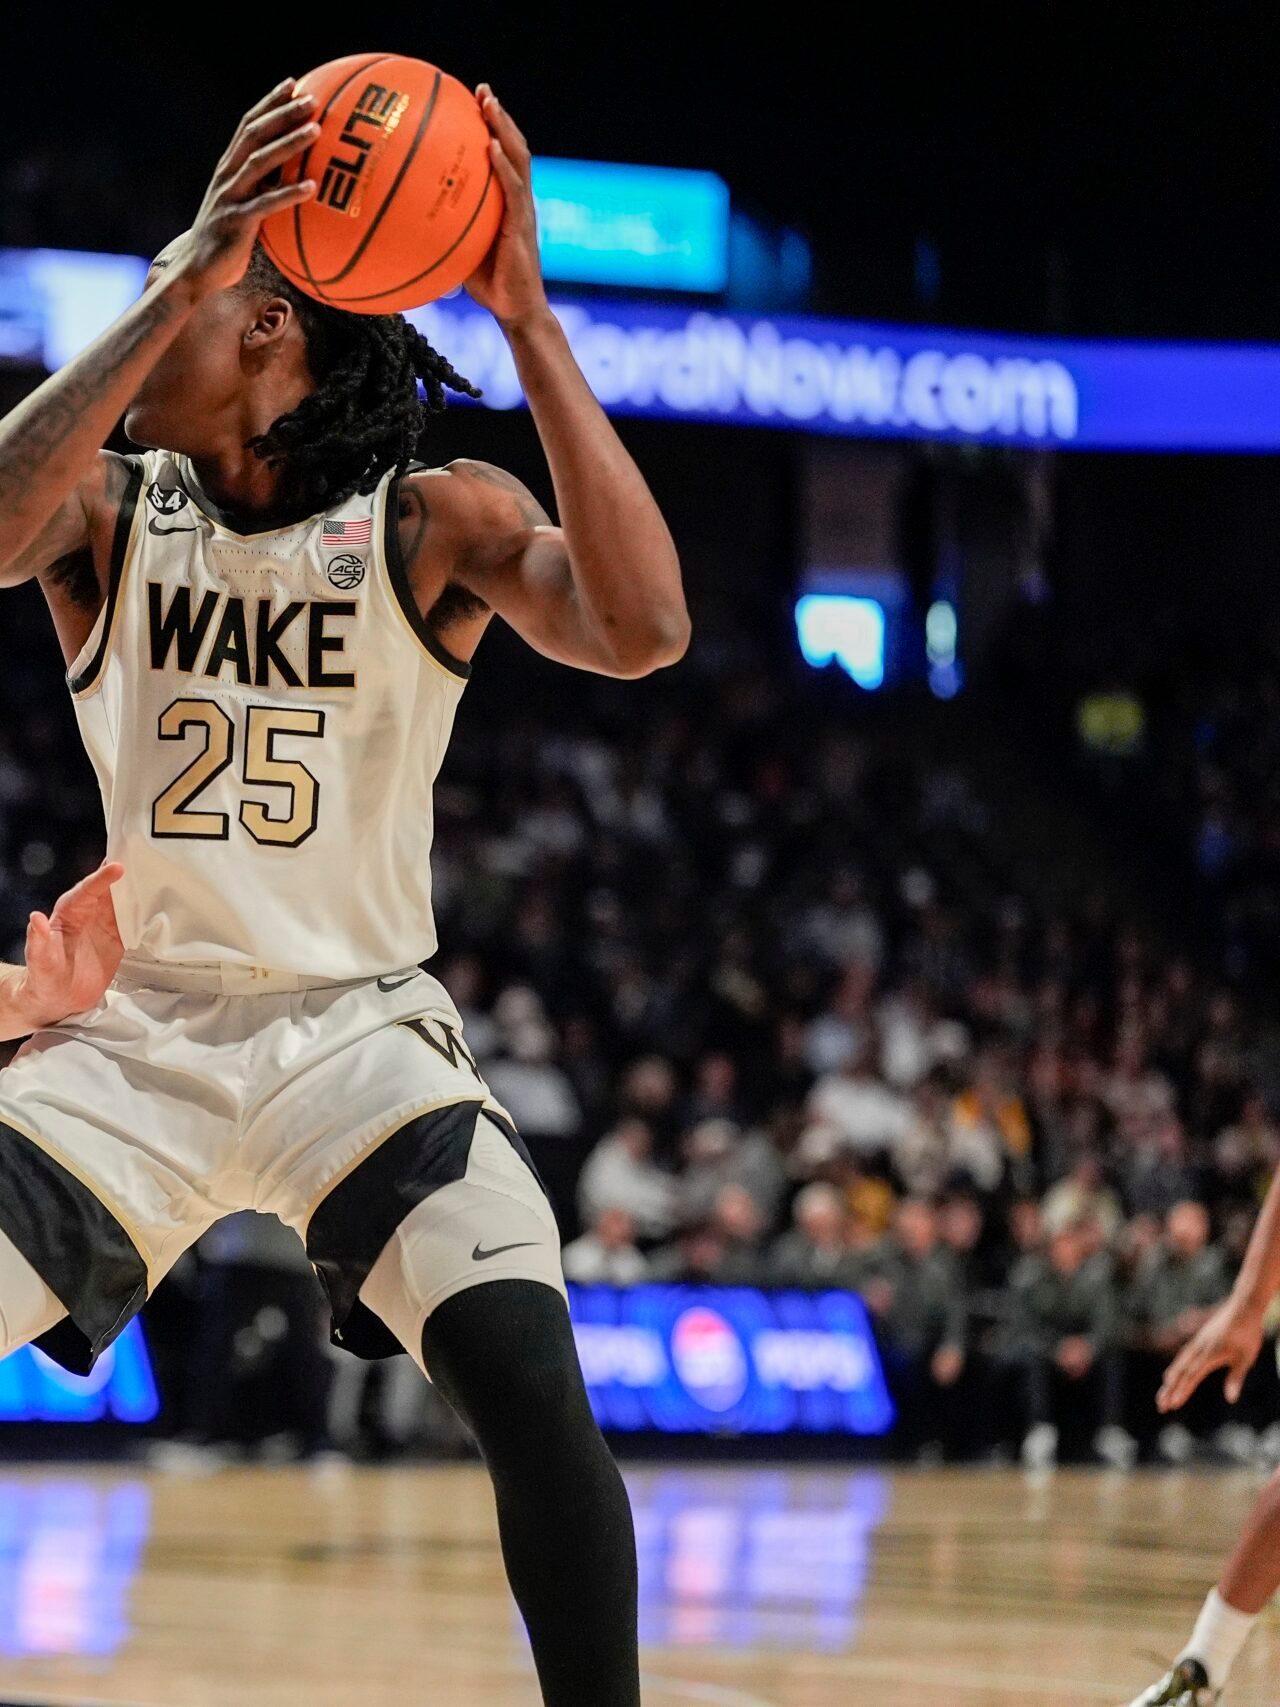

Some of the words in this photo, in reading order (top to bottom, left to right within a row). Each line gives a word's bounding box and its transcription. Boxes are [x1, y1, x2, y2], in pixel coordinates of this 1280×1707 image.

[316, 82, 400, 213] ELITE
[150, 482, 182, 511] 54
[148, 582, 357, 688] WAKE
[151, 698, 326, 848] 25
[396, 1018, 482, 1085] W
